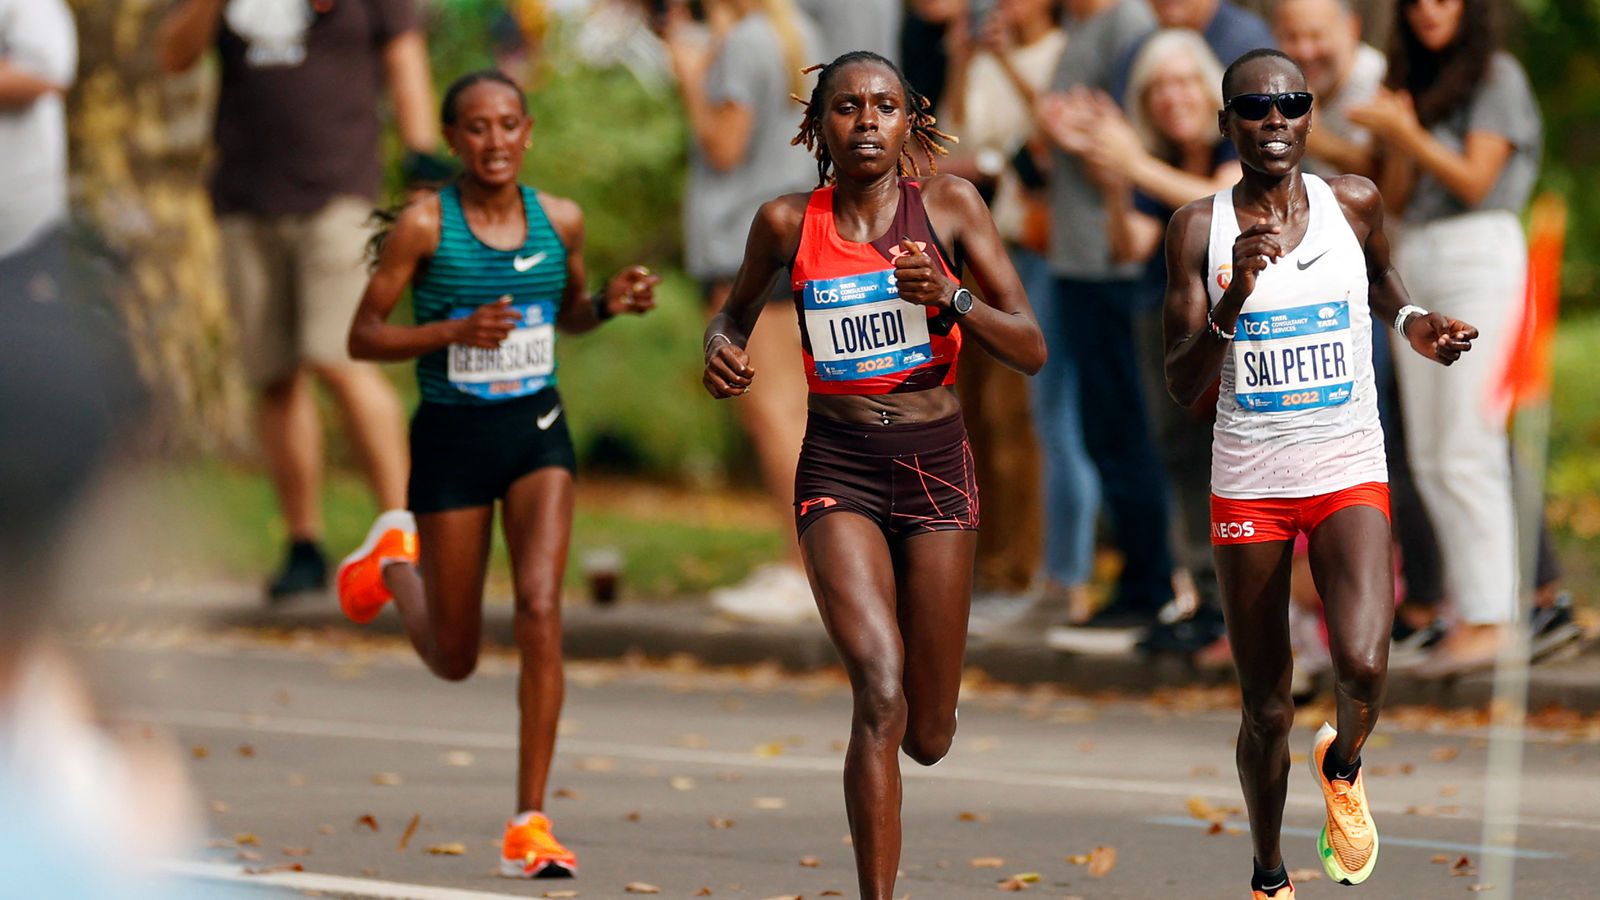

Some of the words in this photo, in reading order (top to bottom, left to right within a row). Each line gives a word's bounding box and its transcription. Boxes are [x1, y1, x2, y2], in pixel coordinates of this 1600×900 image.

[813, 287, 839, 304] tcs
[840, 284, 878, 295] CONSULTANCY
[841, 292, 866, 302] SERVICES
[1244, 319, 1270, 335] tcs
[1271, 318, 1308, 328] CONSULTANCY
[1272, 326, 1297, 334] SERVICES
[1316, 319, 1339, 328] TATA
[829, 309, 906, 354] LOKEDI
[856, 356, 895, 373] 2022
[1244, 341, 1347, 387] SALPETER
[1282, 391, 1320, 406] 2022
